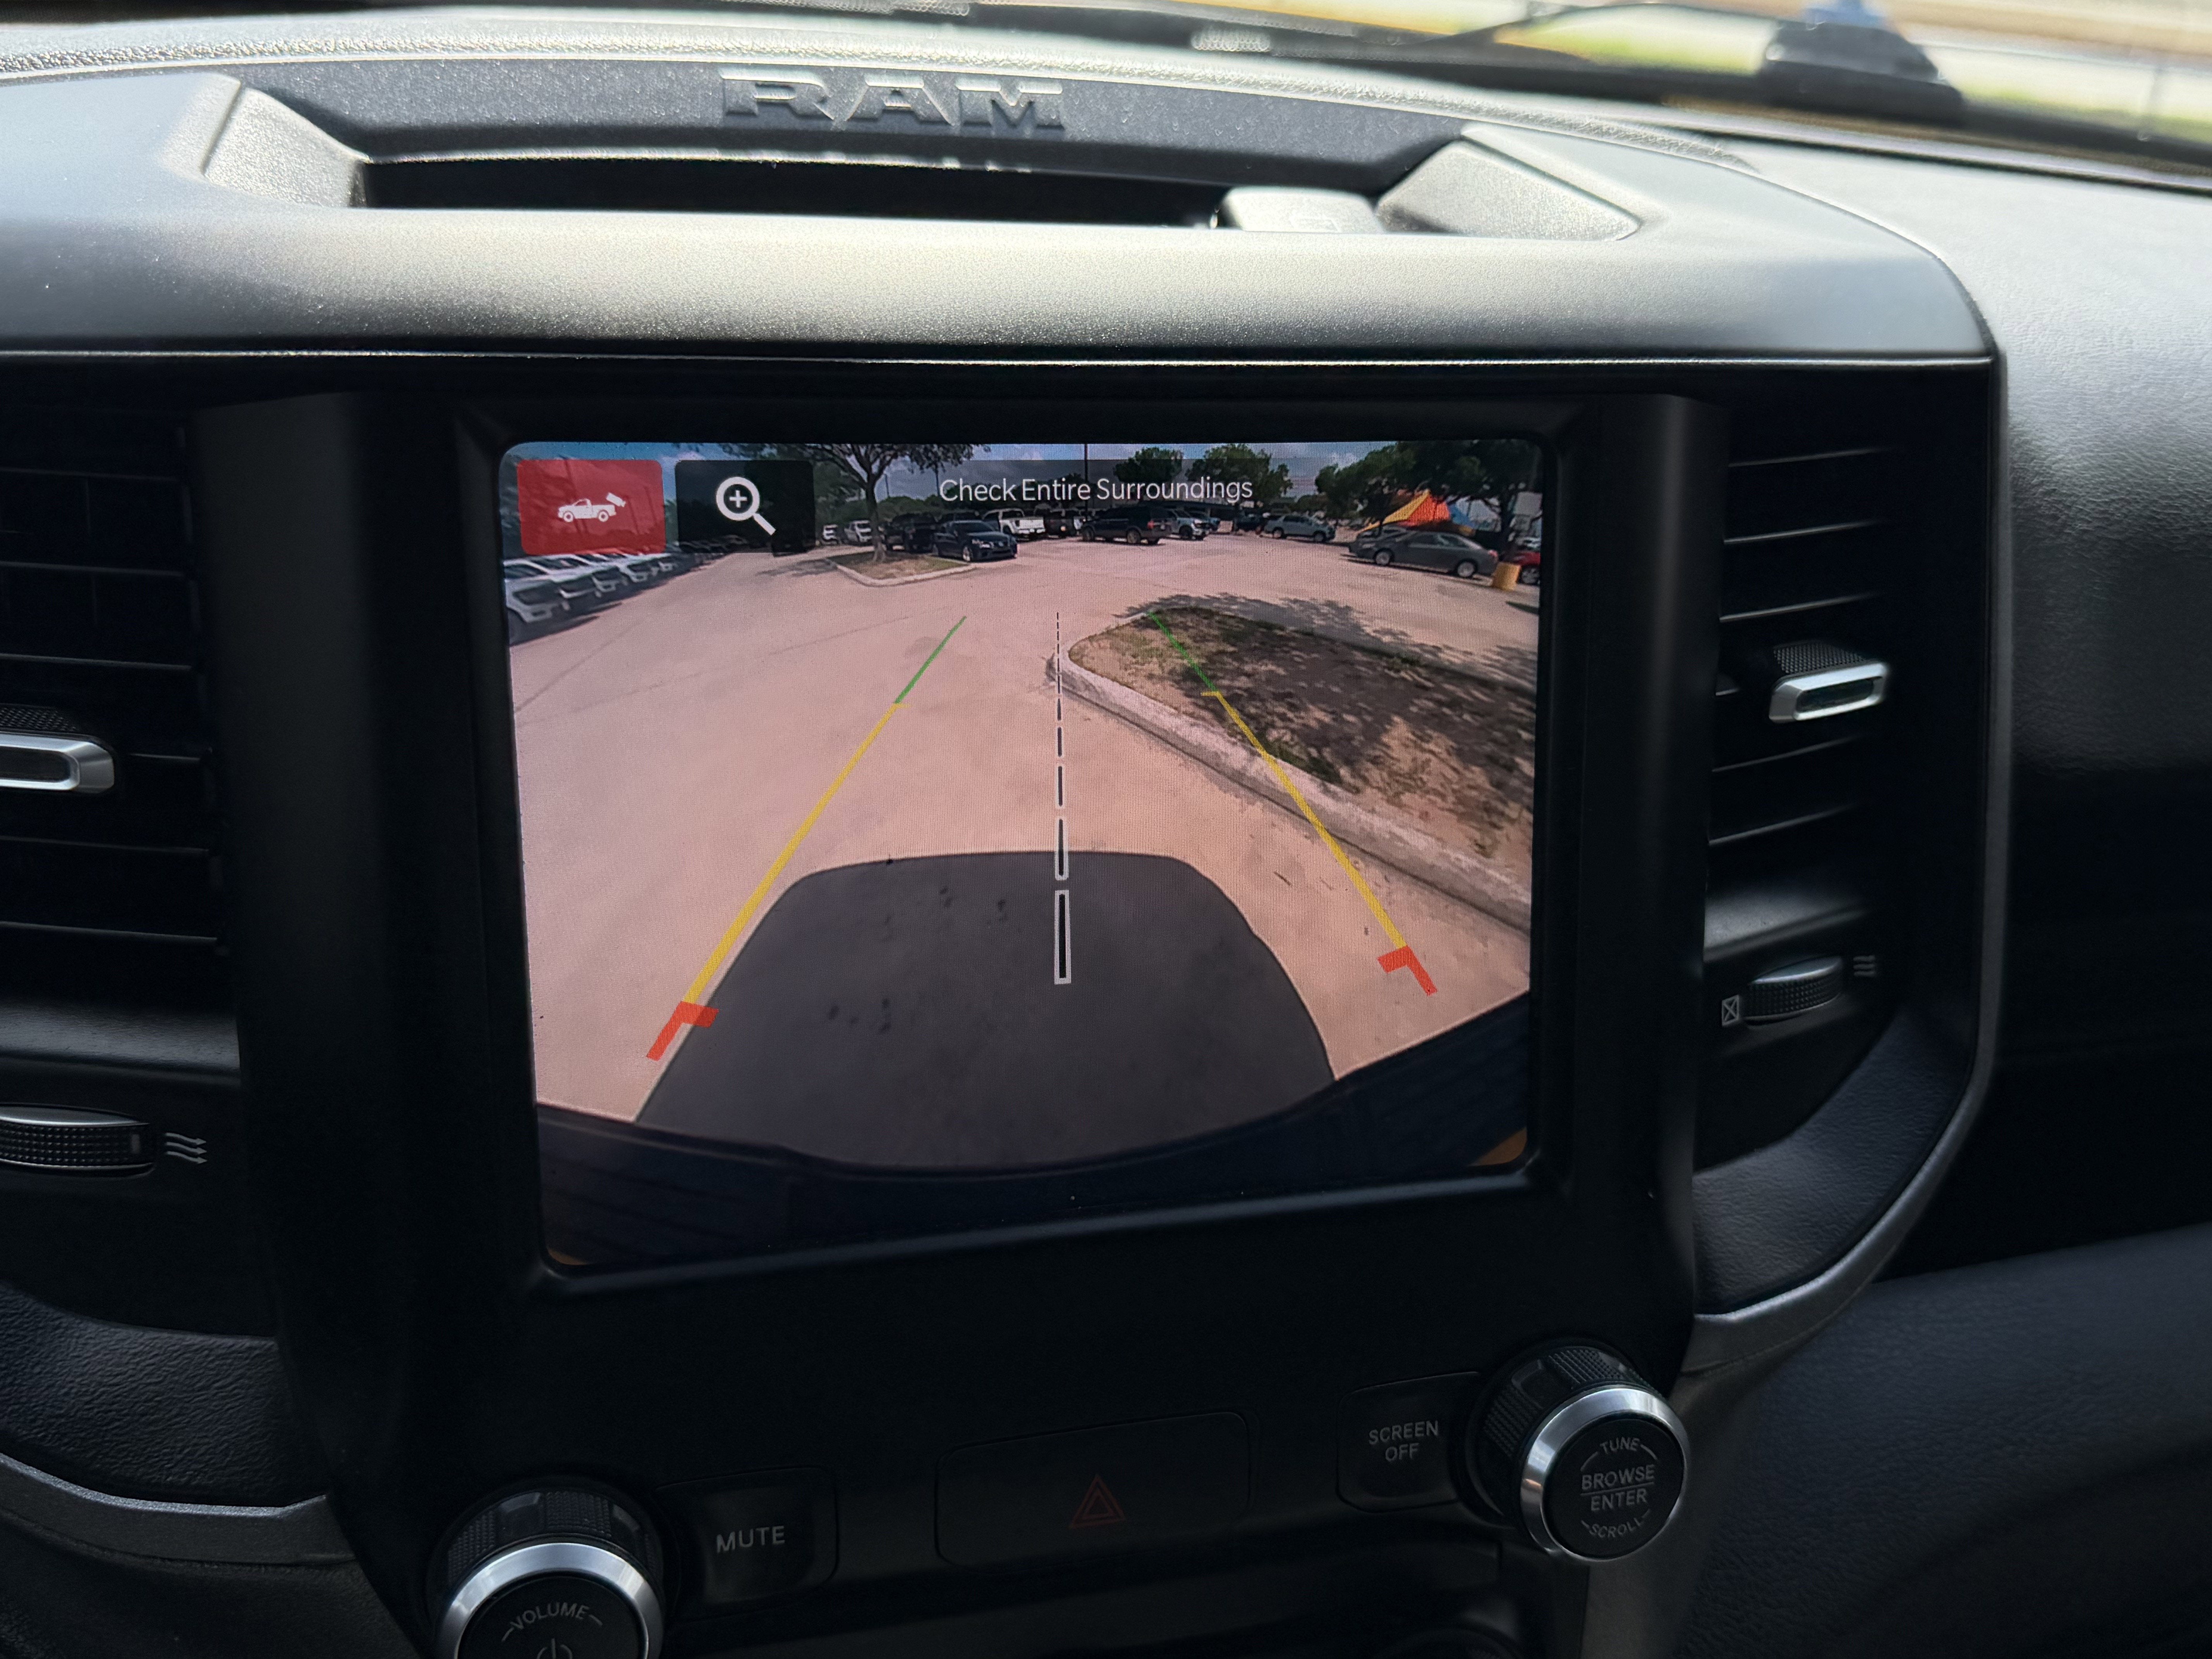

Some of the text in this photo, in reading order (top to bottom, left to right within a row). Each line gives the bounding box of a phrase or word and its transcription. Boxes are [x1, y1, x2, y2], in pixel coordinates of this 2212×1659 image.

[722, 67, 1063, 130] RAM
[939, 476, 1253, 503] Check Entire Surroundings
[1369, 1420, 1439, 1445] SCREEN
[1385, 1443, 1420, 1463] OFF
[1600, 1437, 1640, 1455] TUNE
[1582, 1464, 1655, 1491] BROWSE
[1591, 1489, 1647, 1511] ENTER
[716, 1525, 785, 1554] MUTE
[1589, 1517, 1643, 1539] SCROLL
[511, 1601, 589, 1631] VOLUME
